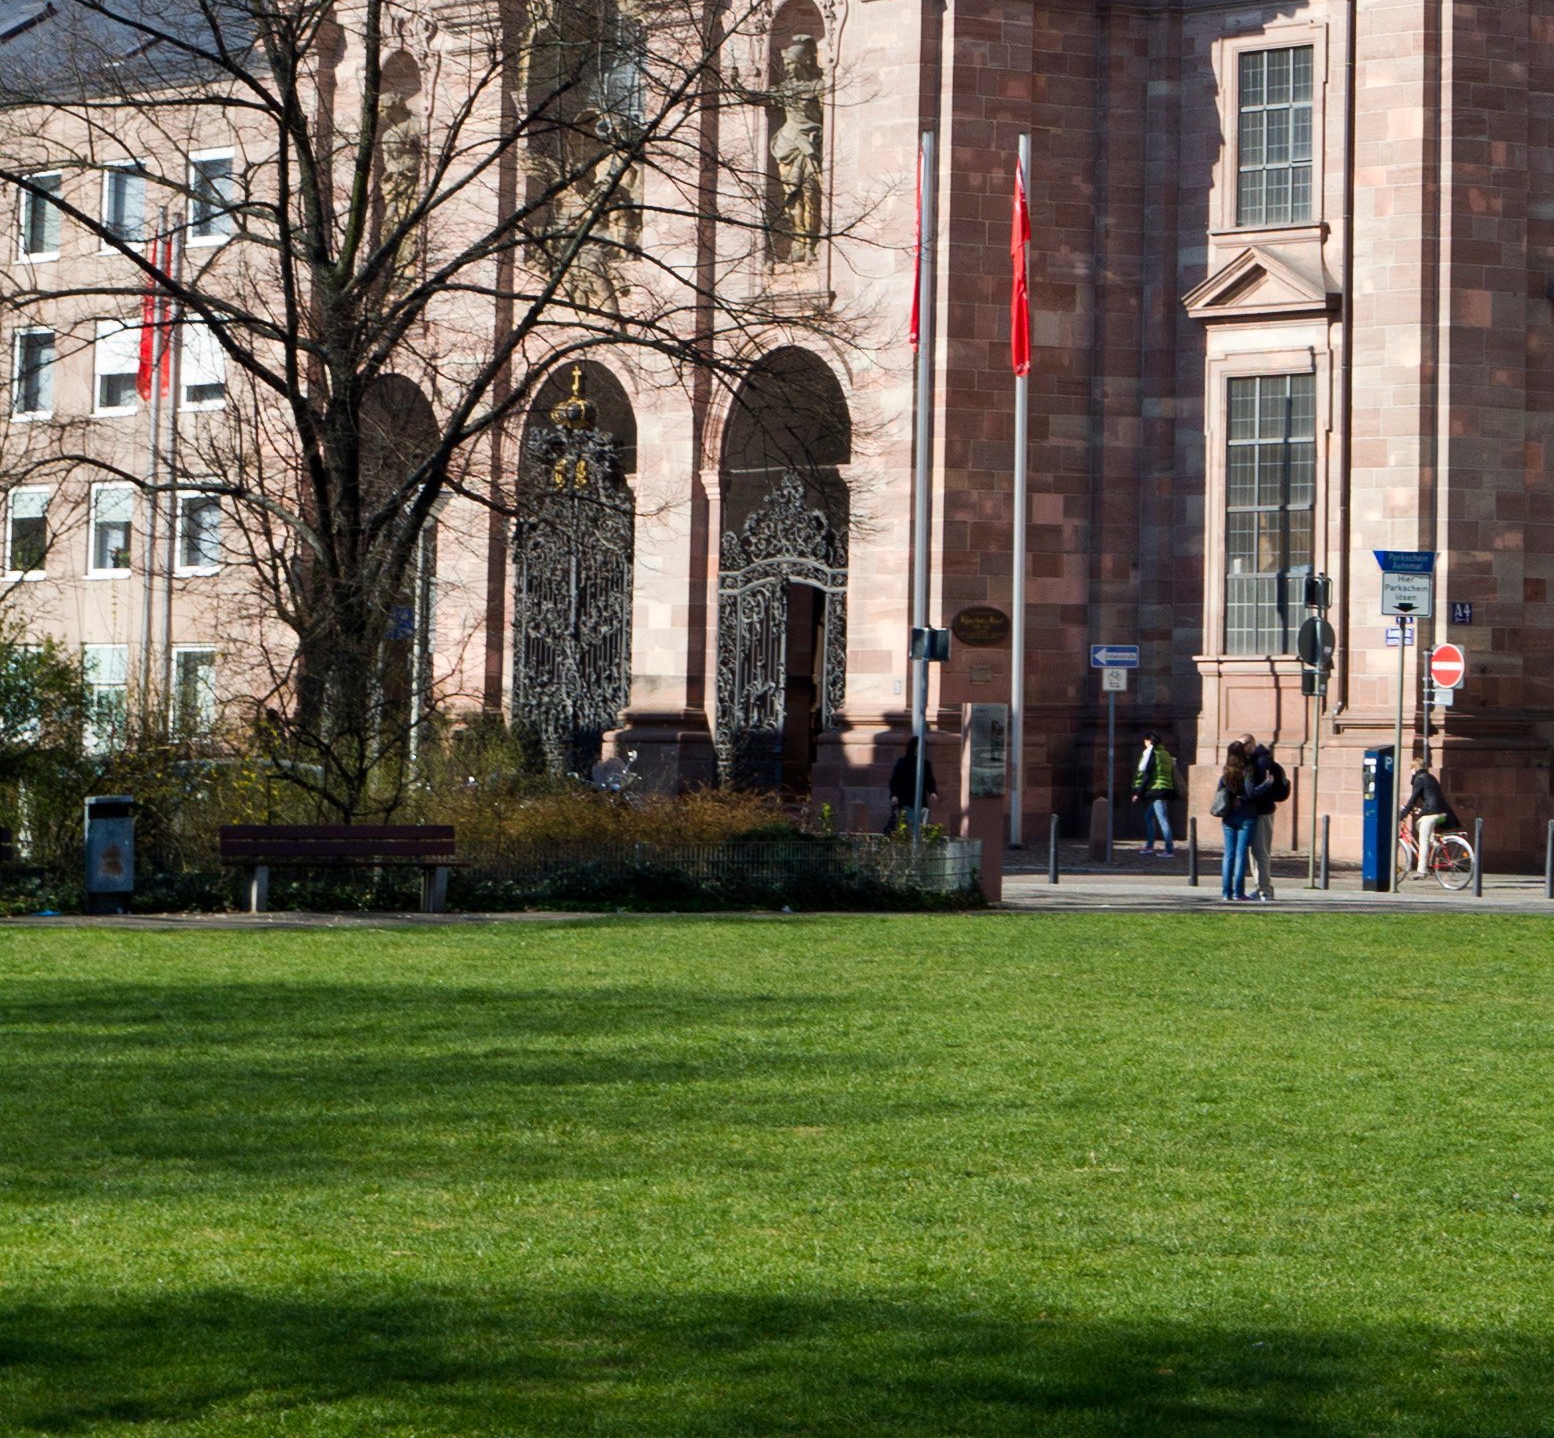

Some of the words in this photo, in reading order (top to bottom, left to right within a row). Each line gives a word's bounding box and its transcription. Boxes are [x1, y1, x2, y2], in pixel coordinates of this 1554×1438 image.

[1388, 553, 1429, 562] Parkschein
[1392, 562, 1423, 570] Automat
[1397, 575, 1414, 583] Hier
[1385, 584, 1429, 592] Parkschein
[1395, 593, 1417, 601] lösen
[1384, 755, 1393, 770] P
